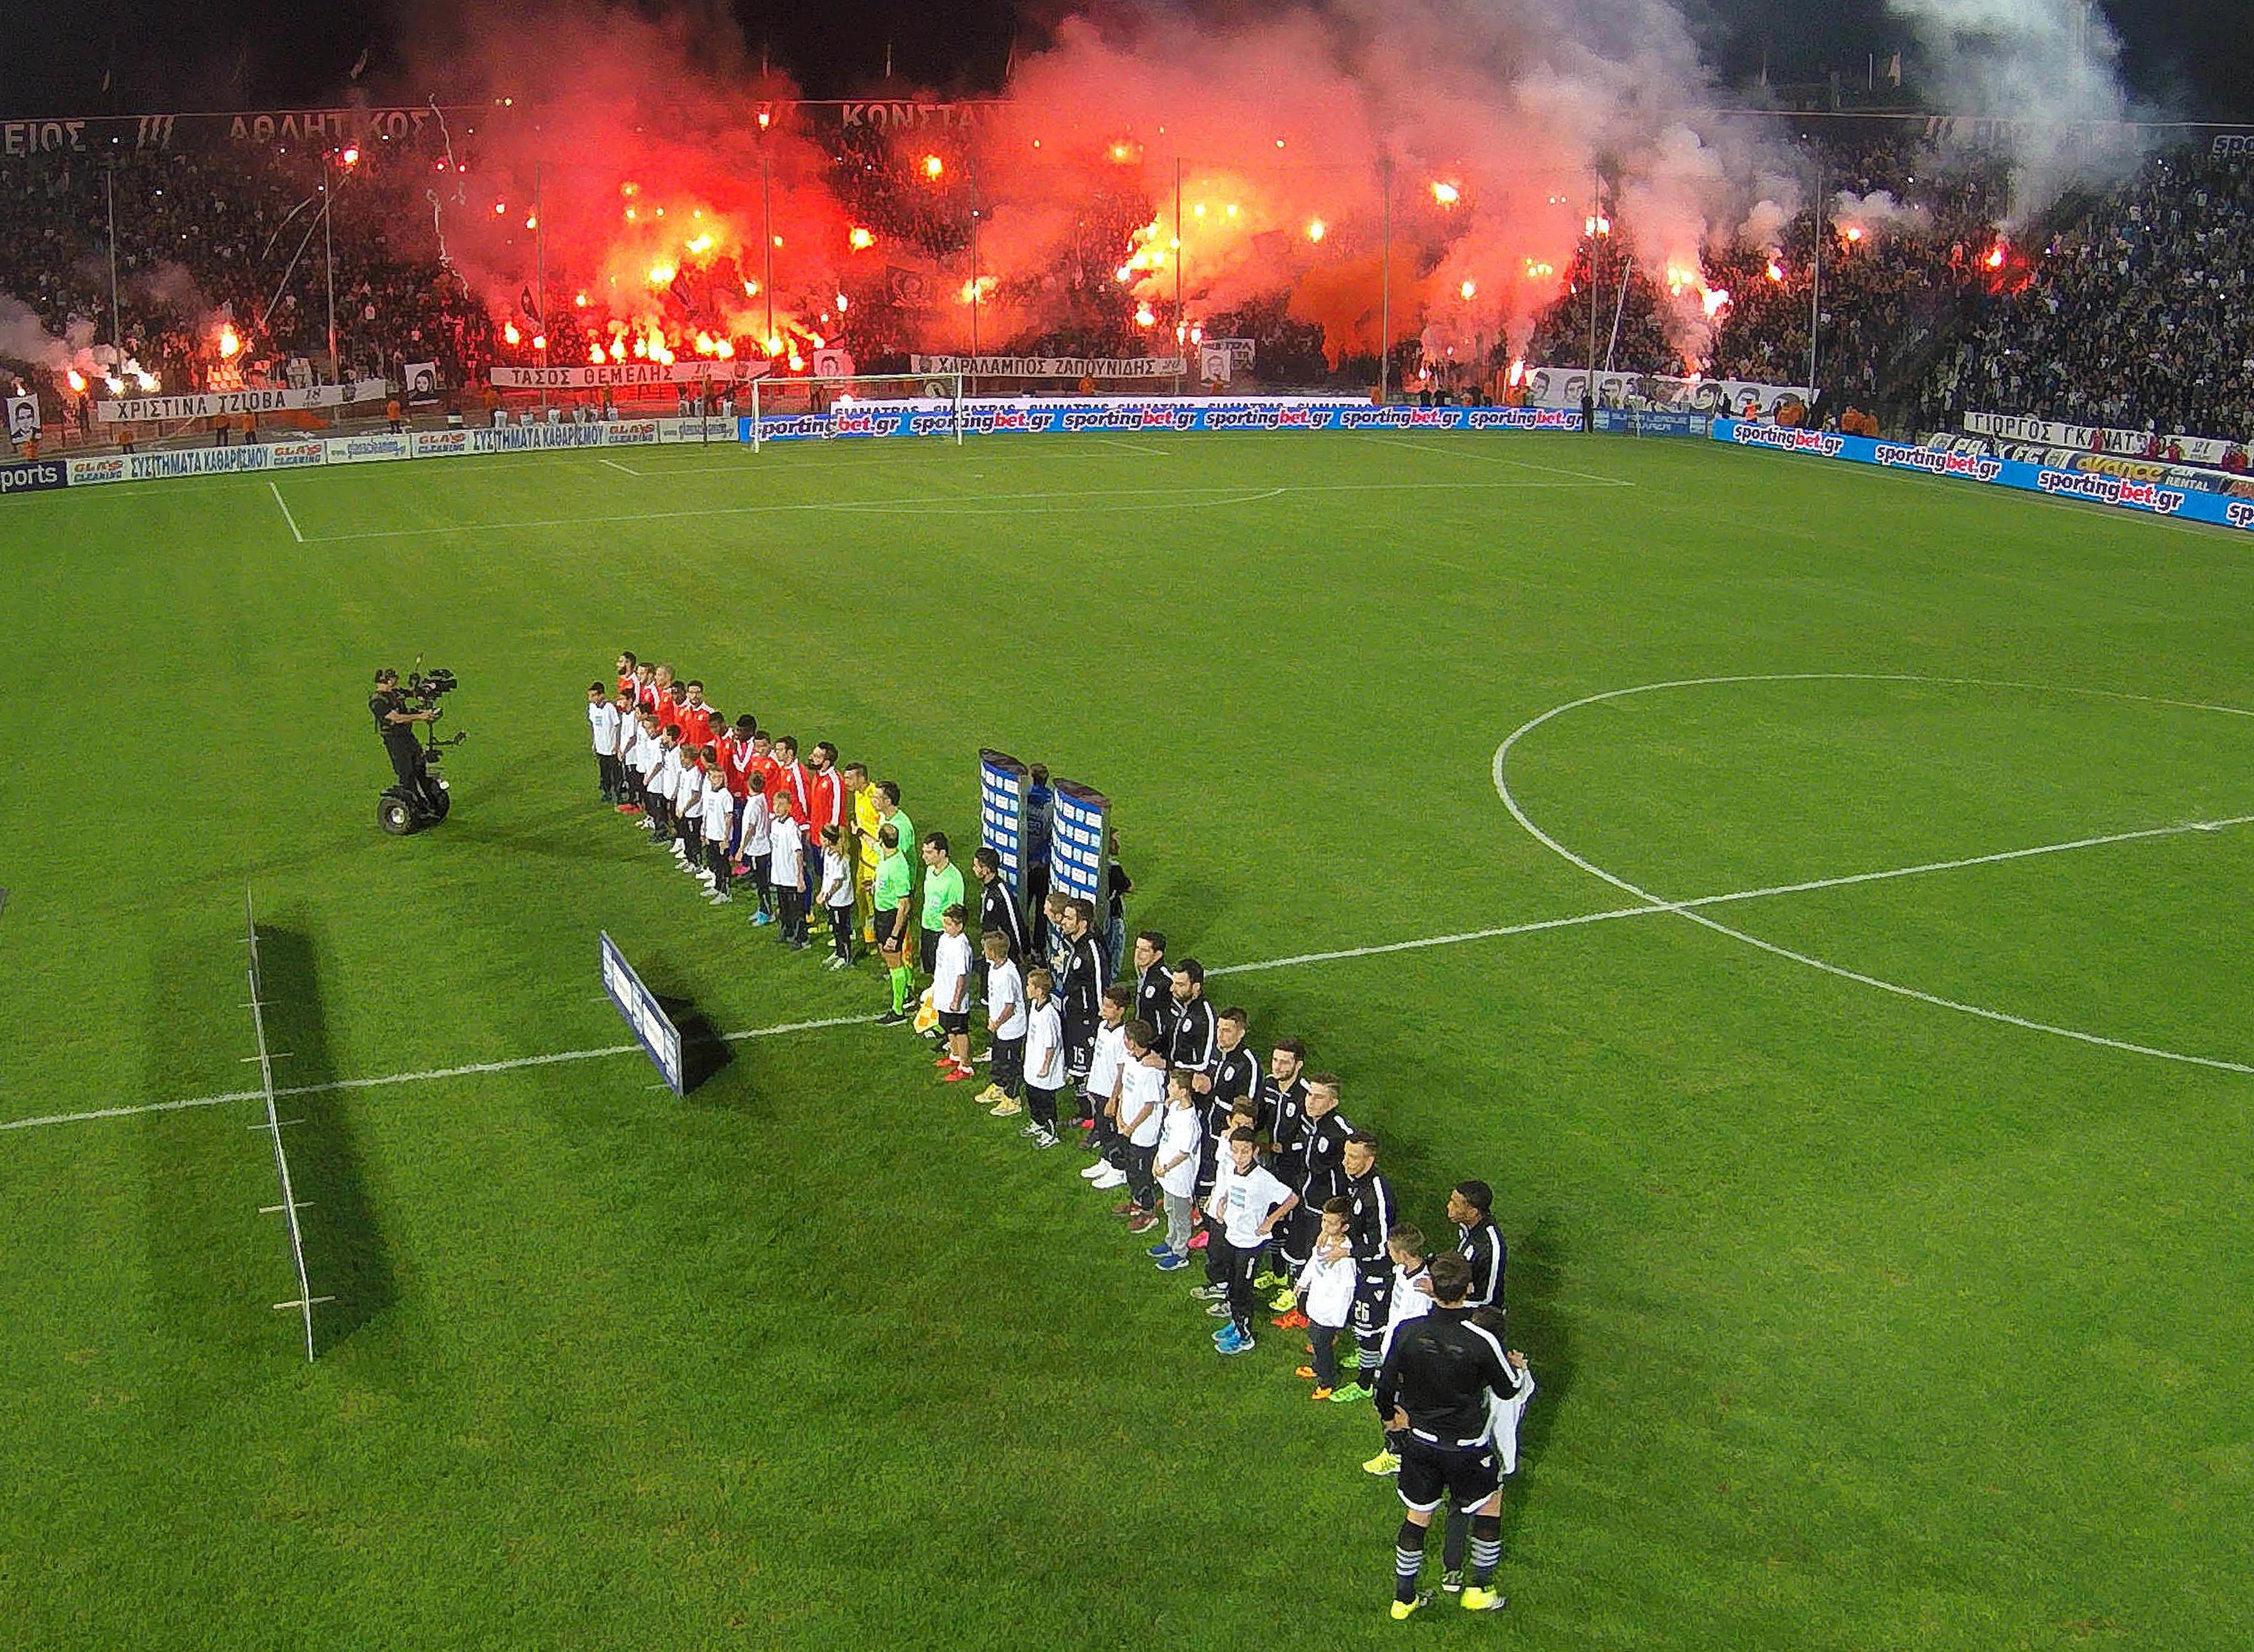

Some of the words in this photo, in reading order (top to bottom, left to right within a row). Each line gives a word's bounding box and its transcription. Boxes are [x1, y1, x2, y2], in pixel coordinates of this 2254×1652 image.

[512, 369, 571, 385] ΤΑΣΟΣ
[584, 366, 673, 384] ΘΕΜΕΛΗΣ
[117, 396, 207, 419] ΧΡΙΣΤΙΝΑ
[1206, 409, 1331, 427] sportingbet.gr
[1342, 408, 1460, 427] sportingbet.gr
[1065, 410, 1196, 428] sportingbet.gr
[1735, 425, 1842, 455] sportingbet.gr
[1877, 446, 2000, 479] sportingbet.gr
[0, 465, 58, 493] ports
[2039, 472, 2182, 510] sportingbet.gr
[2228, 505, 2254, 525] sp
[1073, 1045, 1085, 1064] 15
[1354, 1300, 1370, 1322] 26
